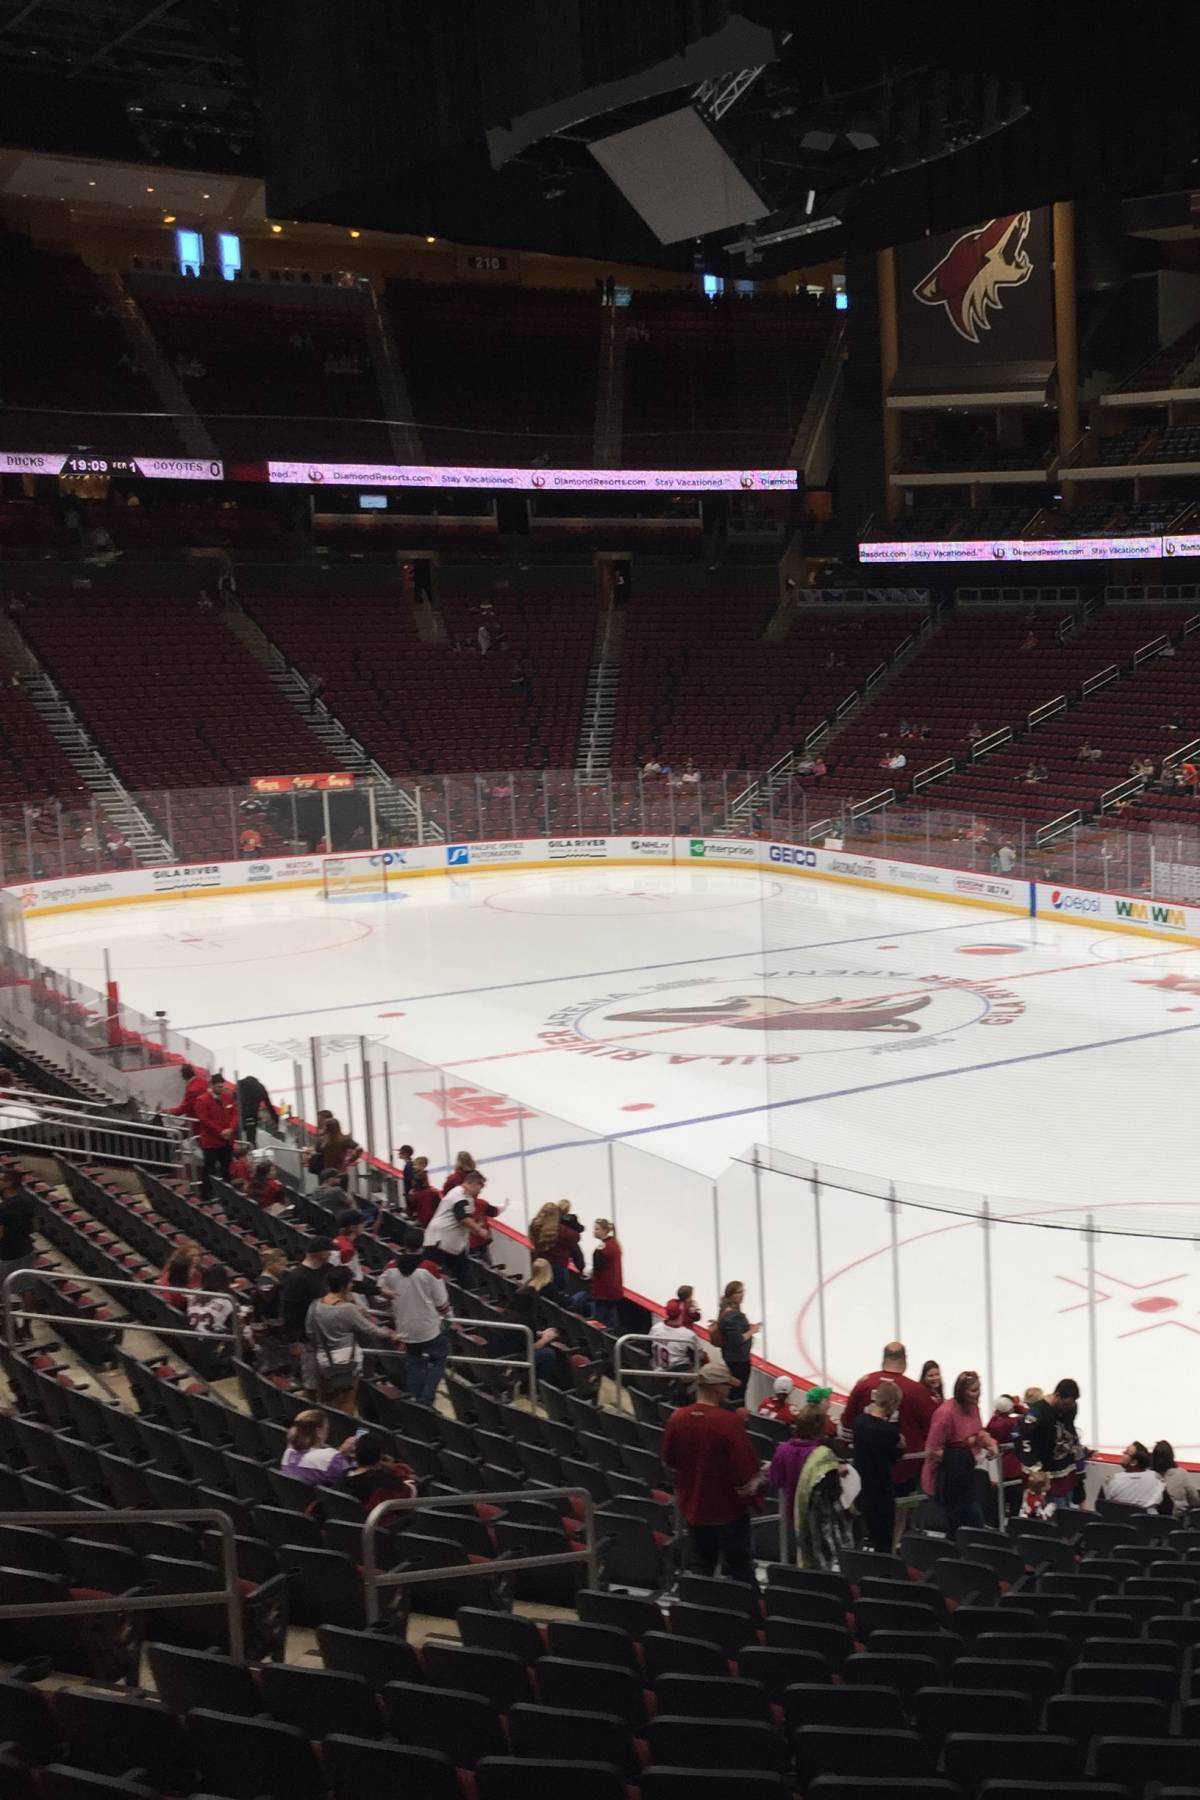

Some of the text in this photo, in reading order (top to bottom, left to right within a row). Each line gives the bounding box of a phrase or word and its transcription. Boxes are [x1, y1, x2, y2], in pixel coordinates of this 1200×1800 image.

[6, 455, 45, 467] DUCKS
[69, 459, 108, 472] 19:09
[153, 460, 220, 477] COYOTES 0
[441, 473, 461, 483] Stay
[554, 477, 646, 486] DiamondResorts.com
[655, 478, 676, 487] Stay
[548, 839, 606, 848] GILA RIVER
[694, 843, 754, 856] enterprise
[368, 851, 406, 867] COX
[769, 845, 817, 867] GEICO
[152, 865, 219, 879] GILA RIVER
[1064, 896, 1102, 913] pepsi
[1116, 900, 1149, 920] WM
[1152, 906, 1186, 926] WM
[668, 1055, 799, 1066] GILA
